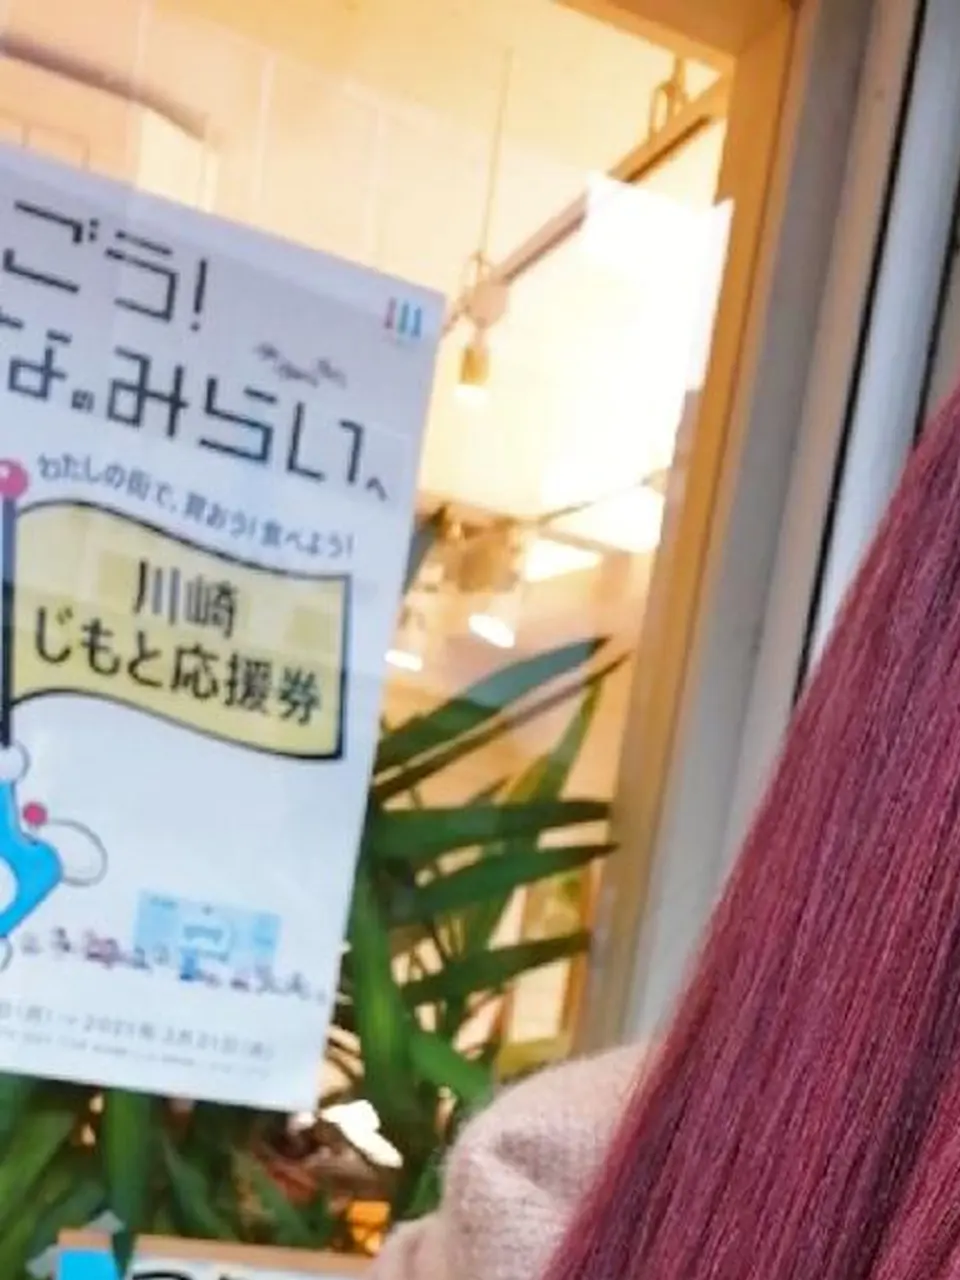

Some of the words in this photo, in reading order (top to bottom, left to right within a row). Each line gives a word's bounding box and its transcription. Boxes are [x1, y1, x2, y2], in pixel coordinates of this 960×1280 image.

[133, 559, 239, 639] 川崎
[35, 605, 322, 726] じもと応援券
